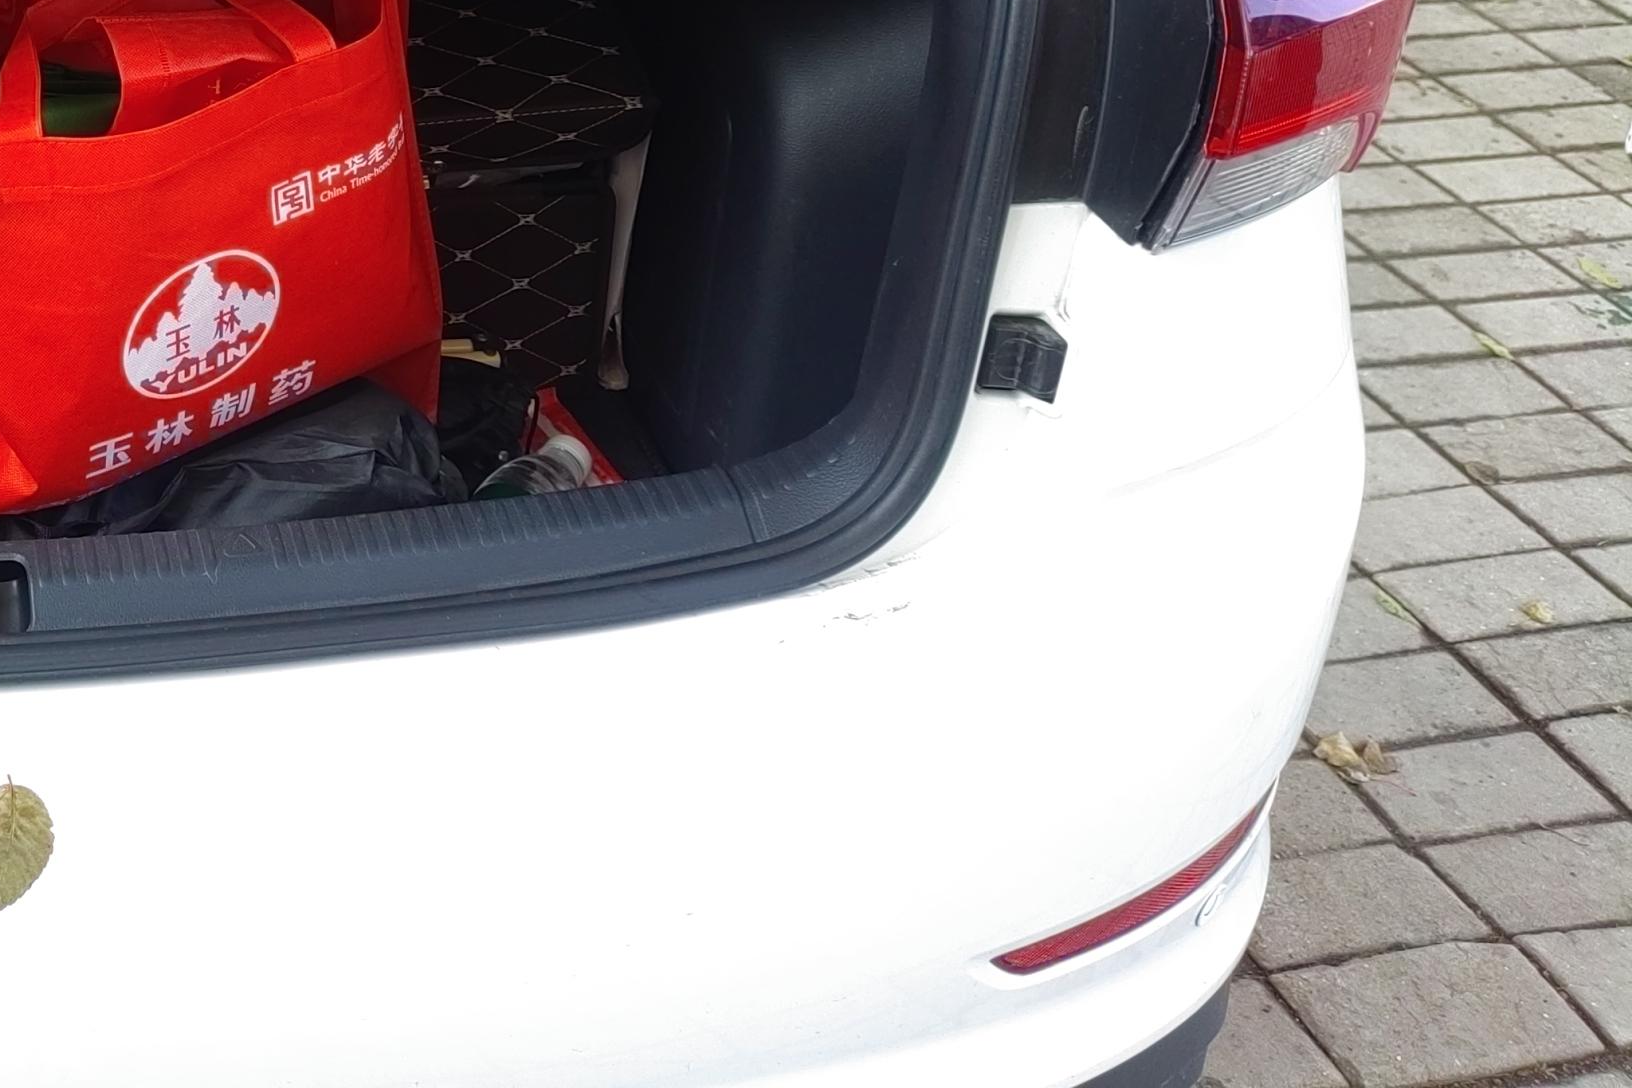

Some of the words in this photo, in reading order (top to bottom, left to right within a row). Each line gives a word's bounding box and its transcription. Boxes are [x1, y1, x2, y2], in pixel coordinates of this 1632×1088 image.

[318, 111, 404, 186] 中华老字
[320, 185, 347, 202] China
[165, 304, 241, 362] 玉林
[150, 341, 248, 393] YULIN
[85, 359, 317, 479] 玉林制药
